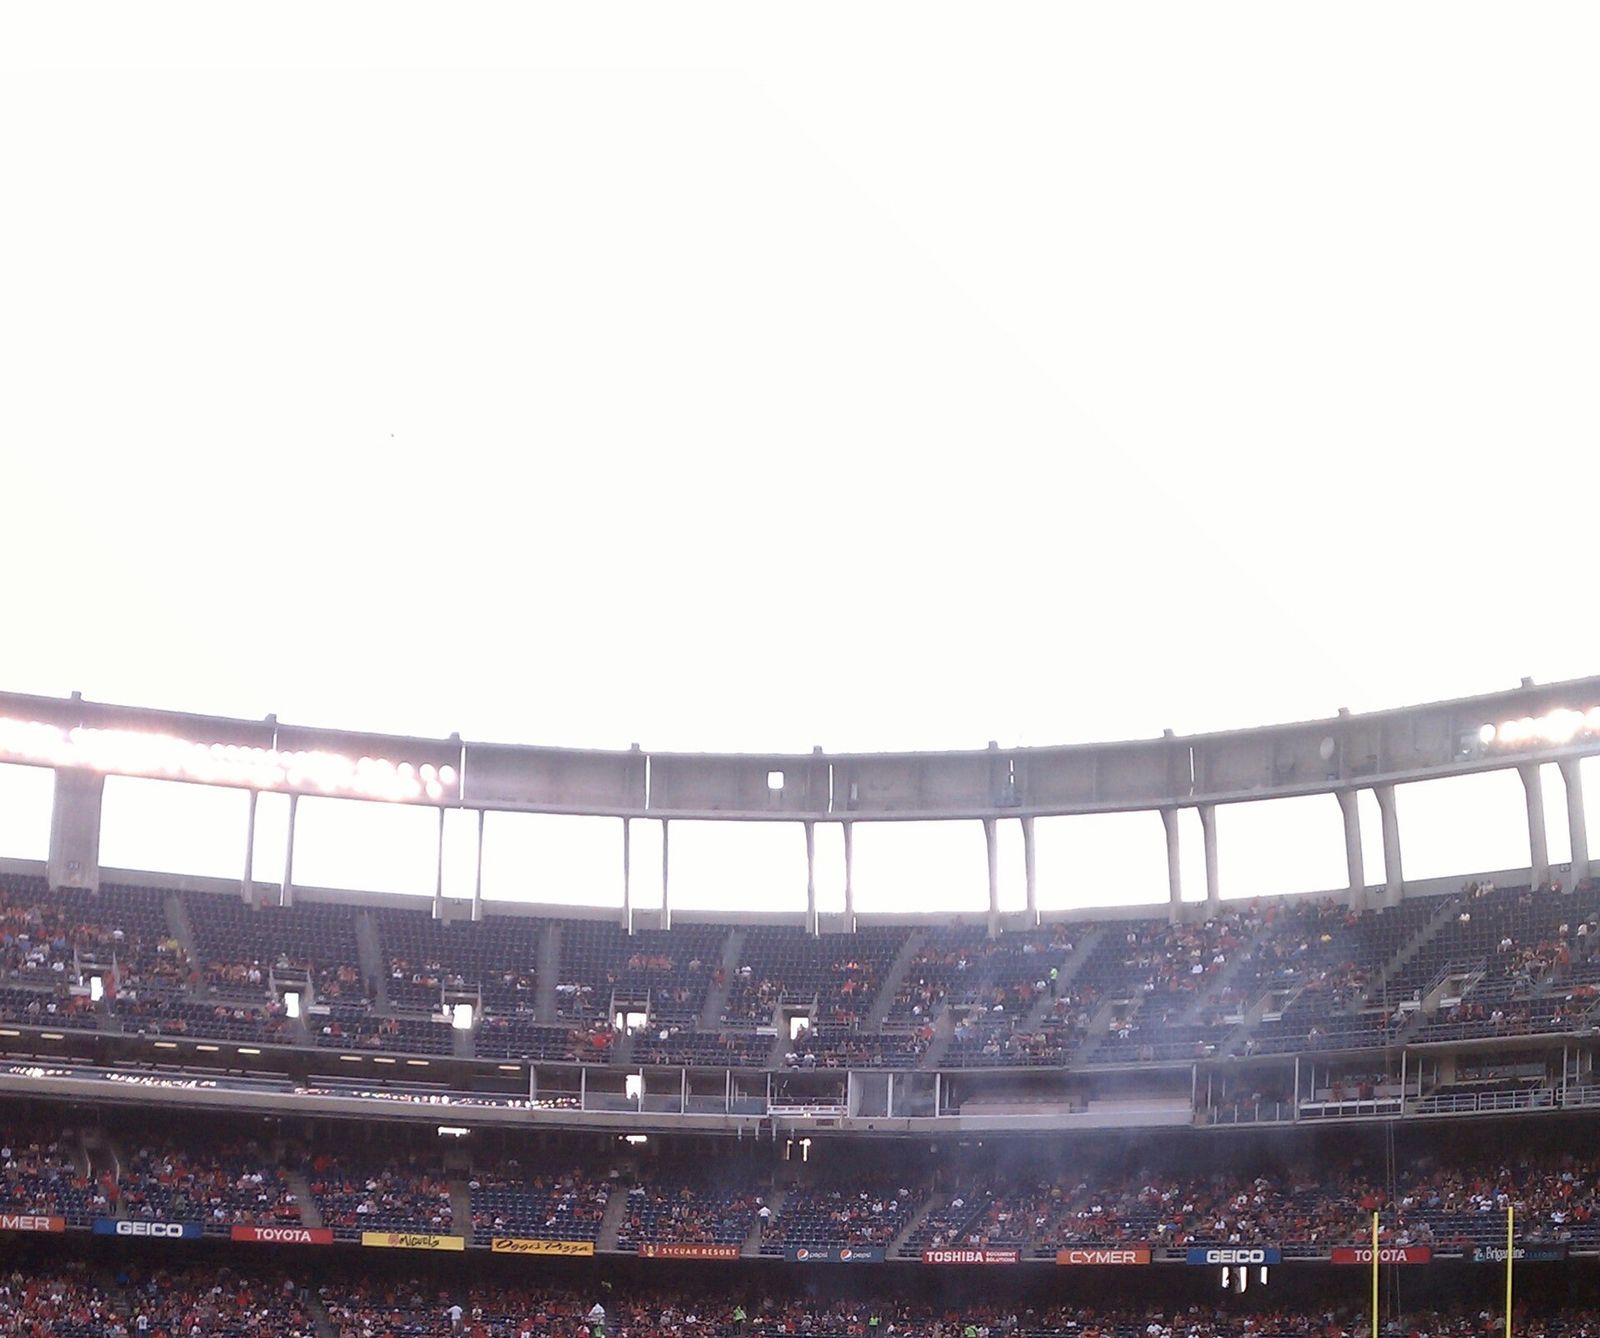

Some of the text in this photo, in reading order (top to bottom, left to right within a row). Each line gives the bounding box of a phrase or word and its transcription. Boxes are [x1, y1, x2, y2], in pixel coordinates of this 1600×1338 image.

[0, 1215, 50, 1231] MER
[116, 1220, 184, 1238] GEICO
[254, 1227, 312, 1242] TOYOTA
[701, 1248, 736, 1257] RESORT
[809, 1251, 828, 1260] pepsi
[853, 1251, 871, 1260] pepsi
[926, 1251, 984, 1263] TOSHIBA
[1069, 1251, 1136, 1263] CYMER
[1206, 1250, 1265, 1263] GEICO
